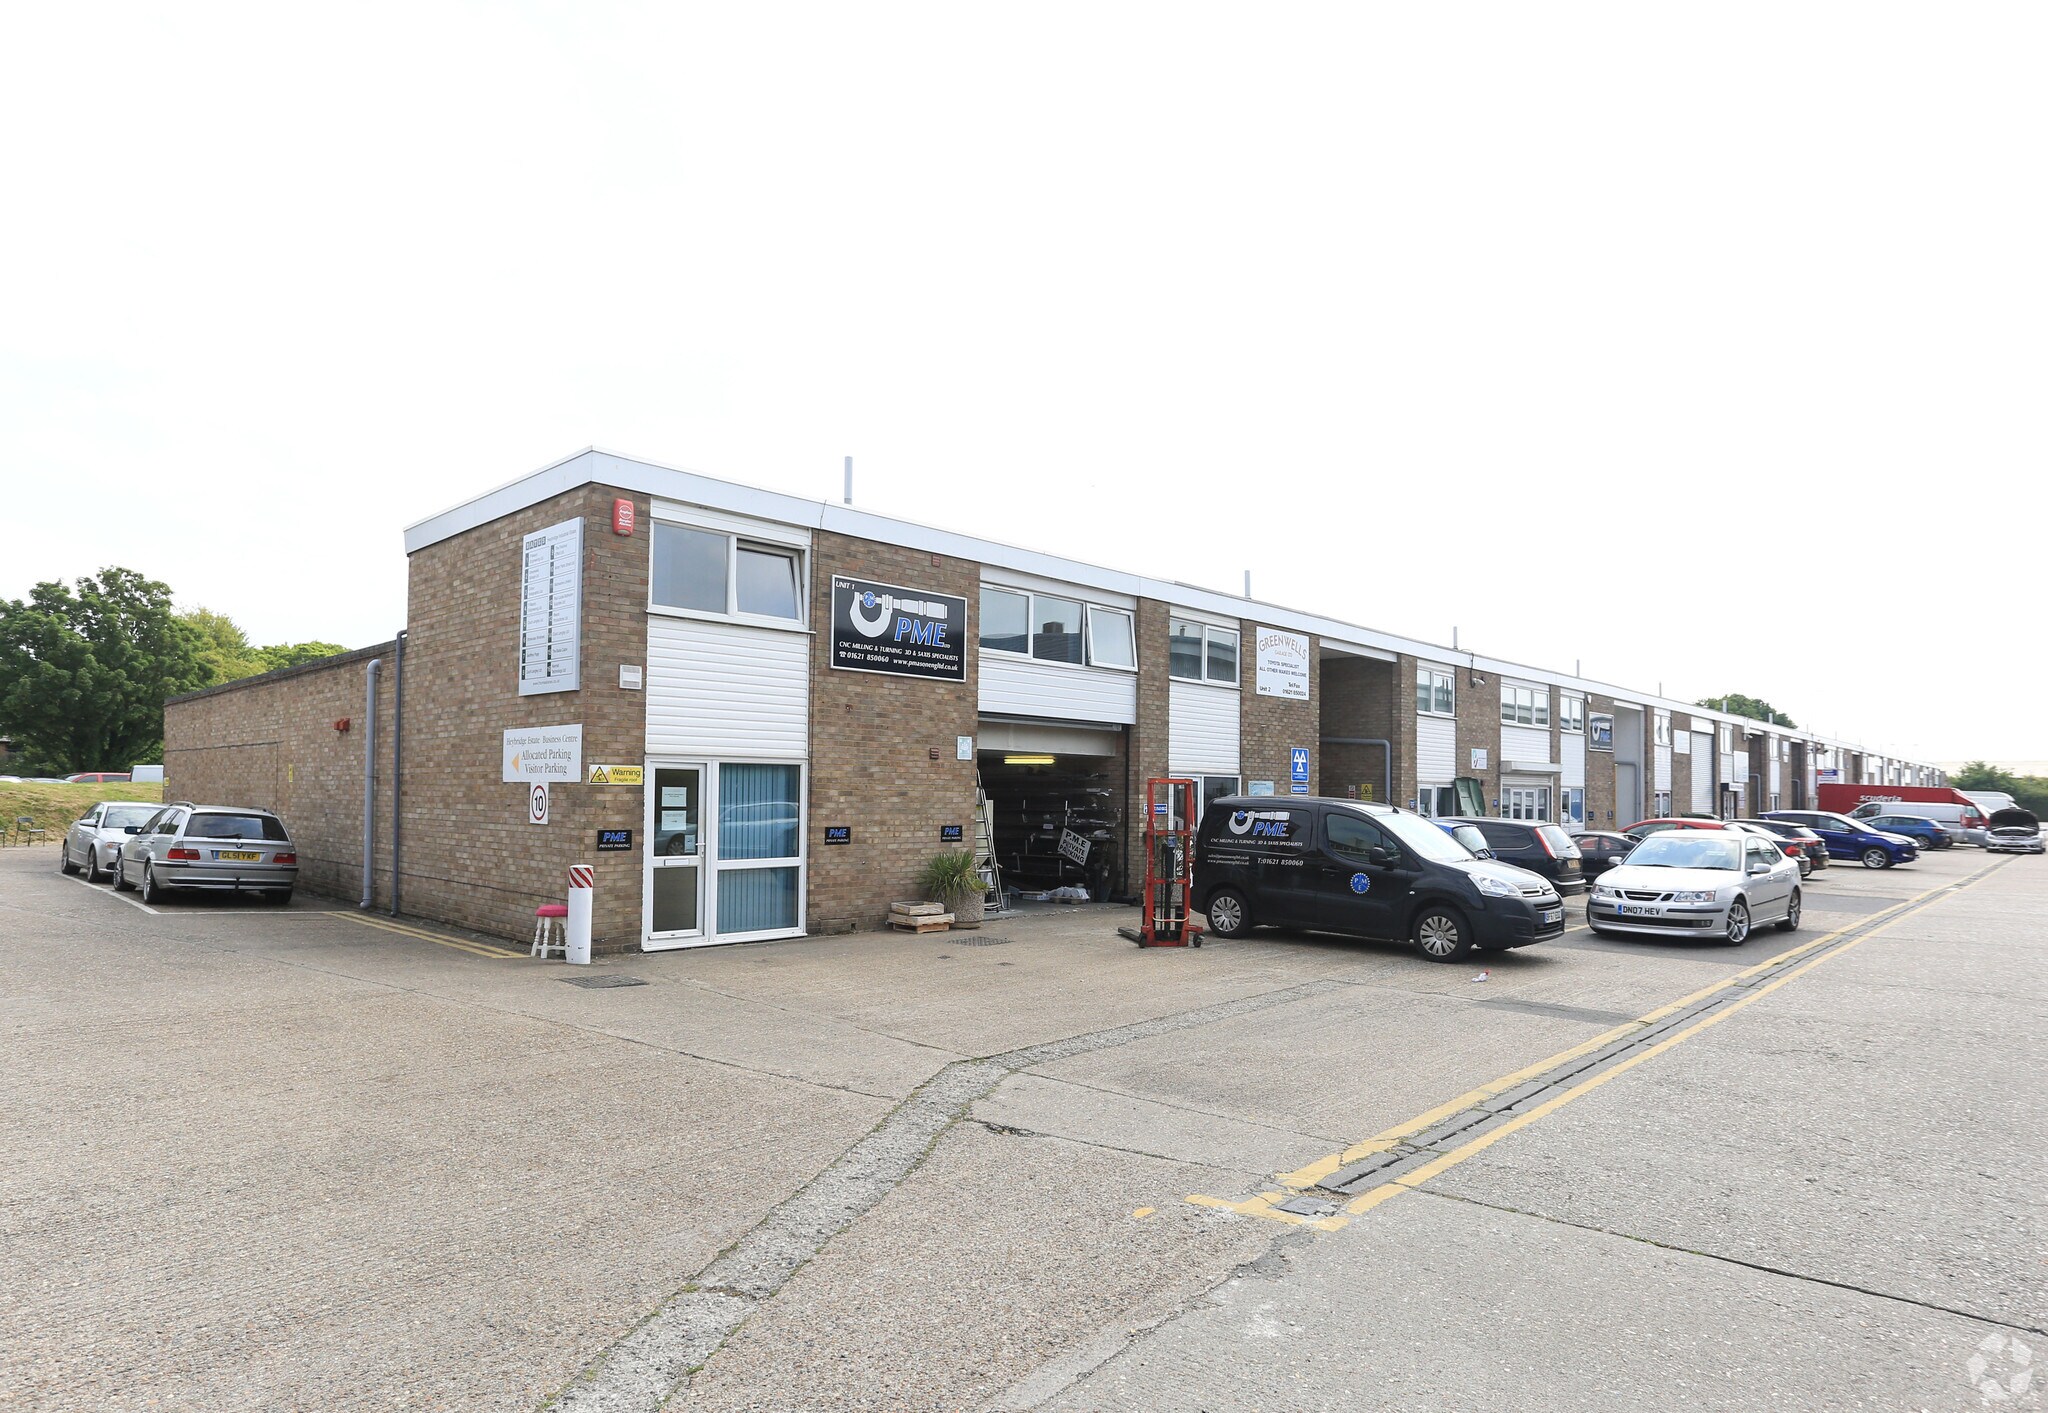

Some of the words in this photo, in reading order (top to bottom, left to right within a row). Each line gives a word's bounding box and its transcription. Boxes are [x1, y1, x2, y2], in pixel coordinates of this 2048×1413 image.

[835, 580, 850, 589] UNIT
[894, 616, 948, 648] PME
[851, 642, 874, 651] MILLING
[880, 645, 902, 655] TURNING
[931, 652, 959, 661] SPECIALISTS
[1258, 634, 1308, 661] GREENWELLS
[846, 651, 864, 660] 01621
[866, 653, 890, 663] 850060
[893, 658, 959, 671] www.pmasonengltd.co.uk
[506, 736, 526, 747] Heybridge
[527, 736, 540, 744] Estate
[542, 734, 562, 744] Business
[562, 734, 578, 743] Centre
[521, 748, 548, 761] Allocated
[548, 748, 572, 762] Parking
[524, 763, 544, 774] Visitor
[544, 763, 568, 776] Parking
[611, 768, 641, 778] Warning
[534, 795, 544, 812] 10
[1859, 794, 1903, 802] scuderia
[828, 828, 847, 838] PME
[944, 826, 960, 836] PME
[1252, 821, 1289, 837] PME
[603, 831, 627, 842] PME
[1065, 831, 1087, 848] P.M.E
[1280, 858, 1304, 866] 850060
[1622, 905, 1643, 914] DN07
[1644, 907, 1661, 916] HEV
